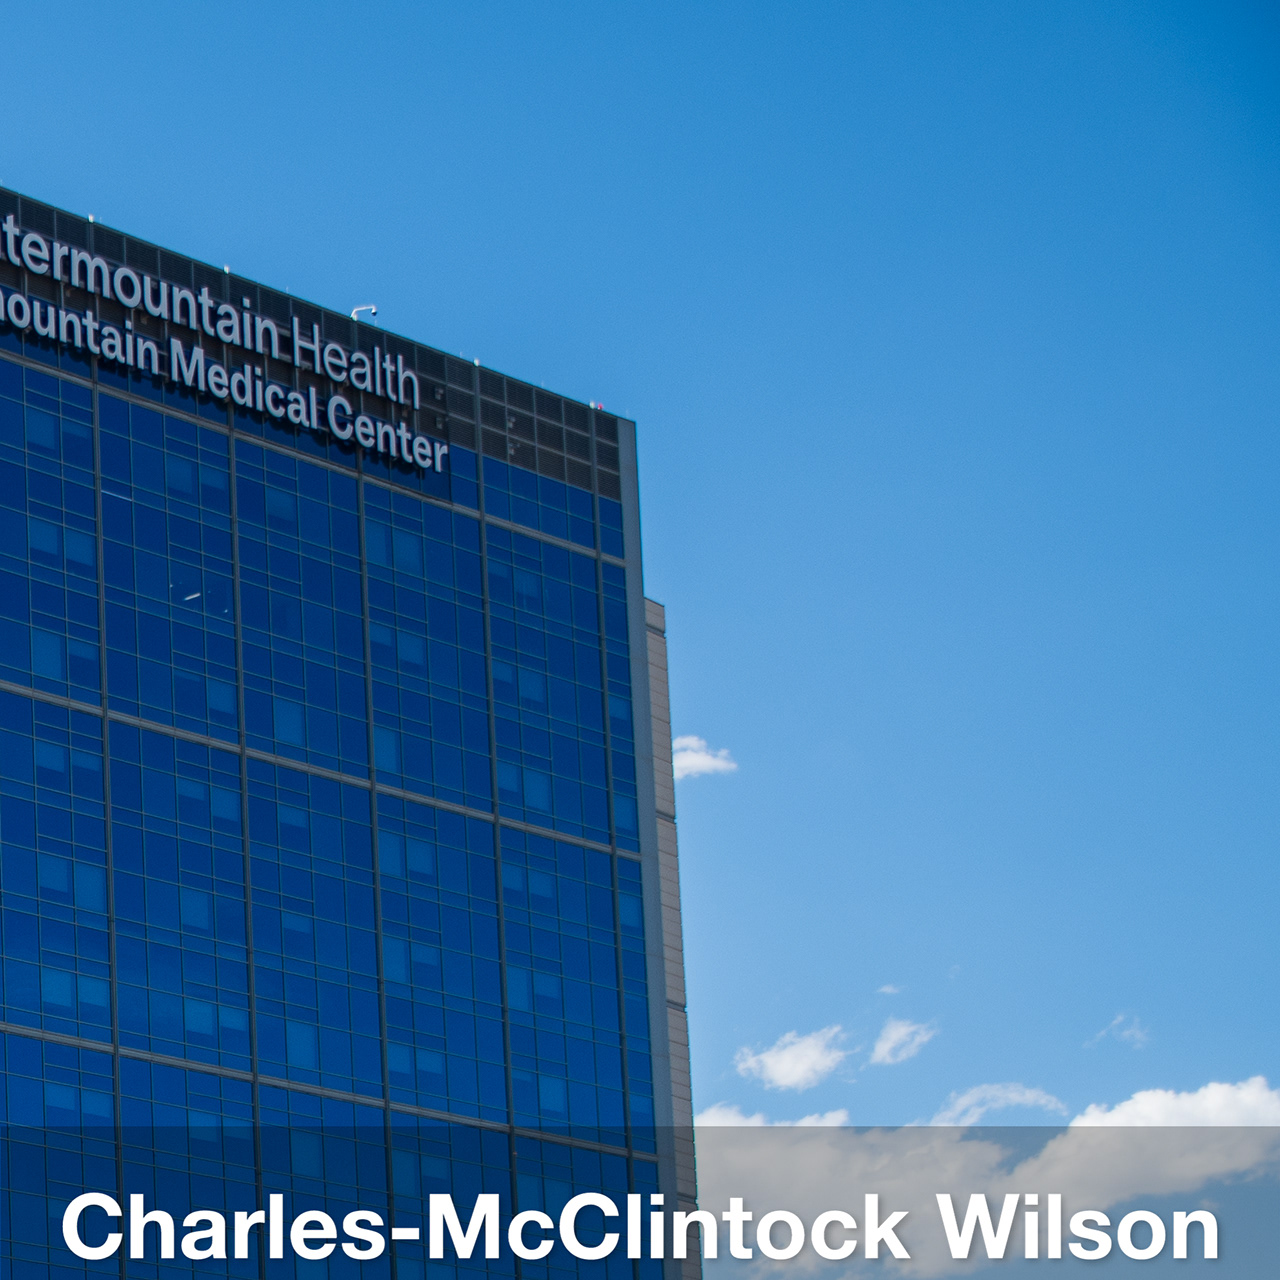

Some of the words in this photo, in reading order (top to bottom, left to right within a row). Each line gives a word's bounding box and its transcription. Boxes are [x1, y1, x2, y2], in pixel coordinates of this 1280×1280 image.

[170, 337, 319, 430] Medical
[327, 394, 449, 473] Center
[292, 316, 421, 411] Health
